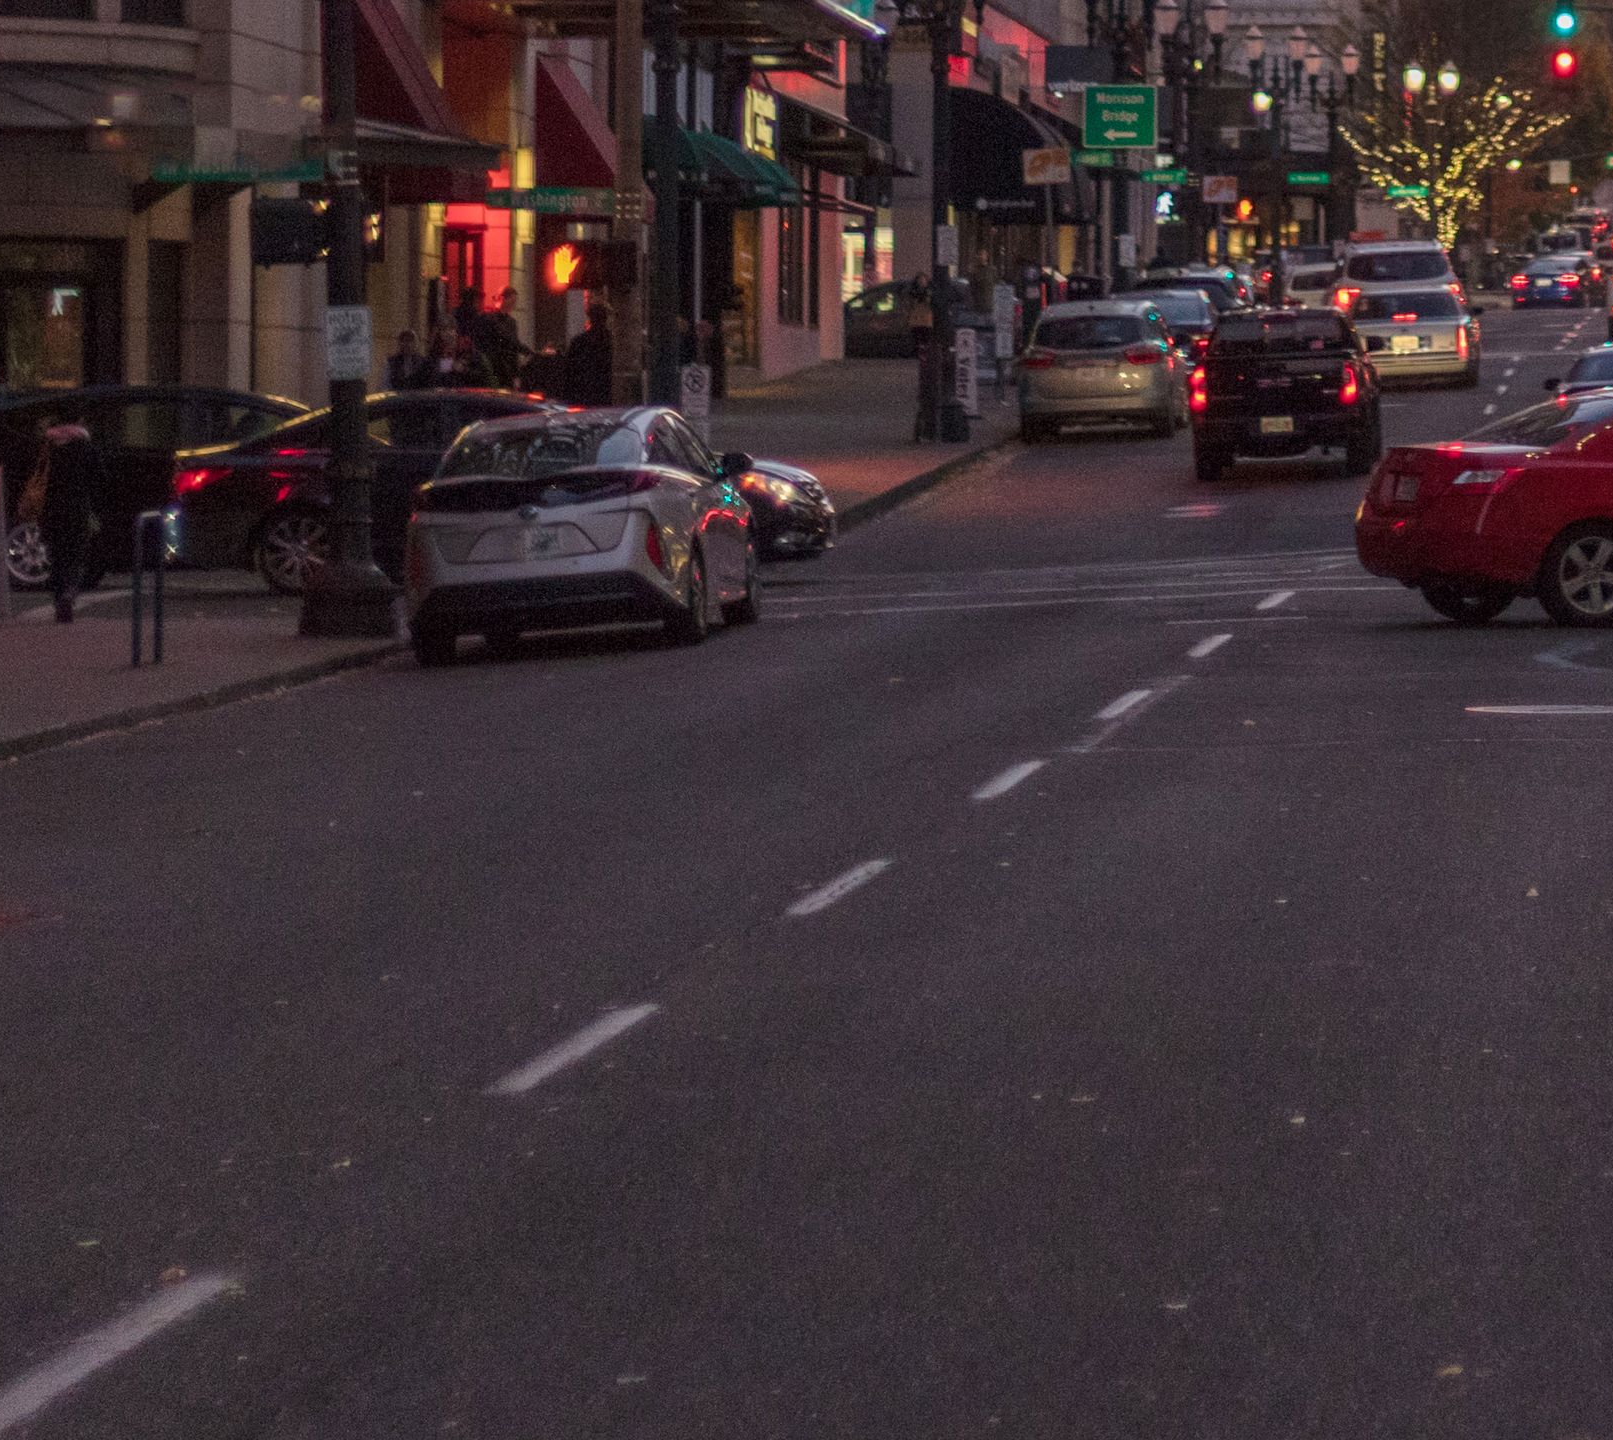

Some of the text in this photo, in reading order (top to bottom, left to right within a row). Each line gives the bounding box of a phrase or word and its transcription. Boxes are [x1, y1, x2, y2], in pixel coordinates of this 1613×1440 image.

[1096, 93, 1145, 104] Morrison
[1102, 110, 1139, 124] Bridge
[512, 192, 588, 213] Washington
